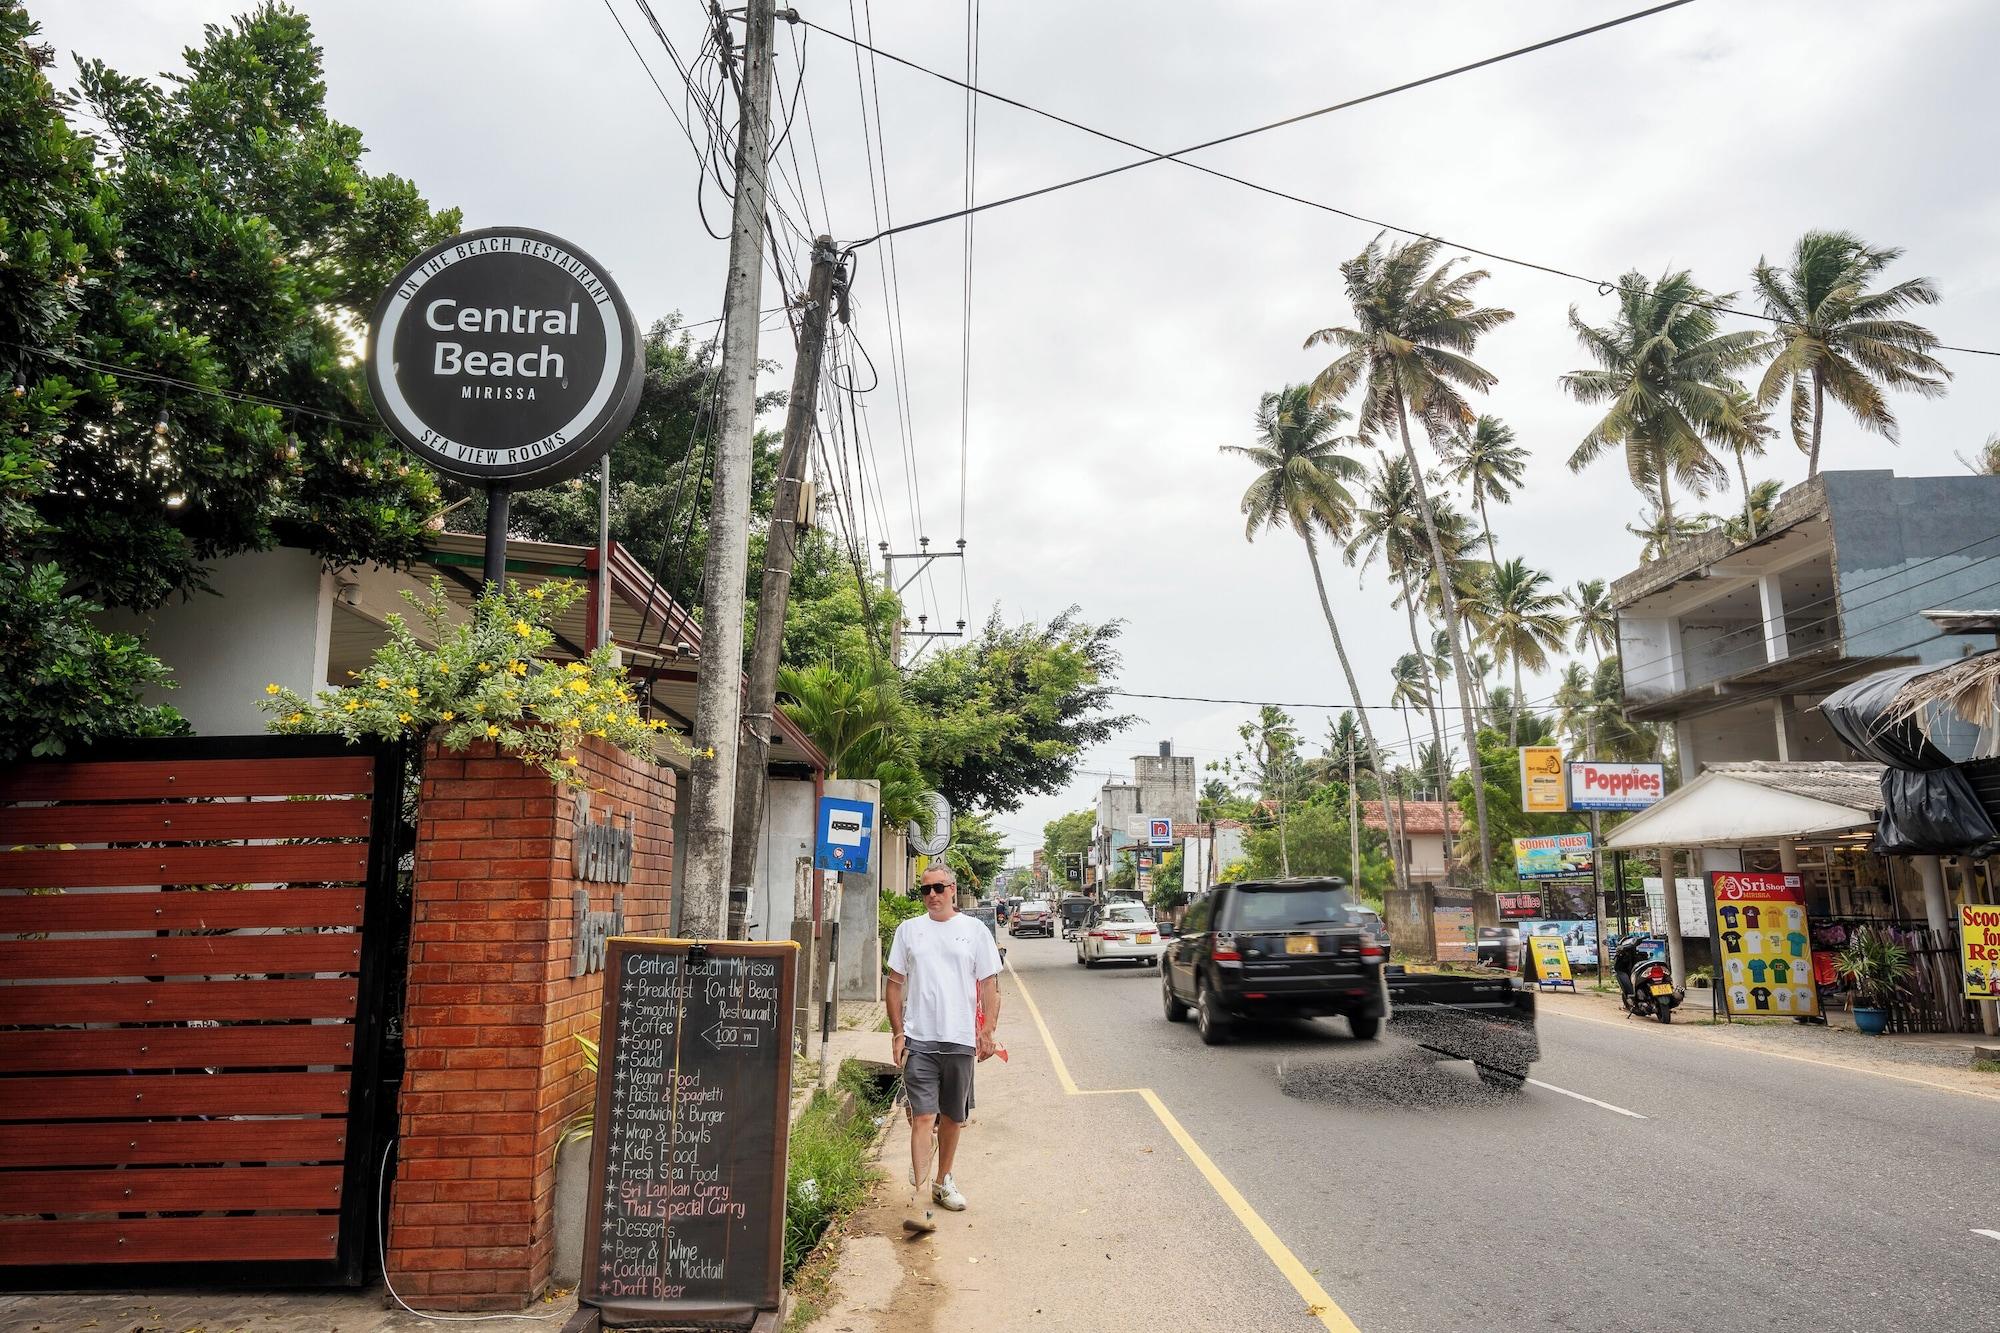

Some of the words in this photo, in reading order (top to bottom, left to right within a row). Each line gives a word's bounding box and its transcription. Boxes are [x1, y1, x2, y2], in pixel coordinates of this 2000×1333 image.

[397, 281, 419, 301] ON
[419, 250, 450, 279] THE
[456, 238, 511, 259] BEACH
[521, 239, 611, 305] RESTAURANT
[425, 298, 580, 335] Central
[433, 341, 564, 378] Beach
[461, 386, 536, 401] MIRISSA
[420, 429, 449, 454] SEA
[457, 446, 498, 464] VIEW
[509, 432, 566, 463] ROOMS
[1585, 767, 1660, 796] Poppies
[1520, 839, 1556, 850] SOORYA
[1558, 836, 1588, 847] GUEST
[1741, 878, 1766, 892] Sri
[1766, 884, 1785, 892] Shop
[1962, 905, 2000, 927] Scoo
[1967, 943, 2000, 961] Re
[627, 954, 678, 975] Central
[729, 957, 775, 977] Mirissa
[637, 978, 693, 999] Breakfast
[728, 980, 743, 999] the
[748, 980, 778, 999] Beach
[635, 1002, 687, 1018] Smoothie
[631, 1017, 674, 1035] Coffee
[715, 1029, 737, 1043] 100
[743, 1033, 752, 1042] m
[631, 1034, 663, 1054] Soup
[629, 1051, 663, 1068] Salad
[629, 1070, 663, 1090] Vegan
[668, 1069, 700, 1086] Food
[629, 1086, 659, 1103] Pasta
[662, 1088, 671, 1103] &
[675, 1086, 724, 1106] Spaghetti
[627, 1104, 672, 1122] Sandwich
[676, 1107, 685, 1121] &
[689, 1107, 726, 1126] Burger
[626, 1126, 653, 1144] Wrap
[655, 1125, 667, 1141] &
[674, 1125, 711, 1144] Bowls
[623, 1143, 653, 1161] Kids
[661, 1142, 698, 1163] Food
[621, 1162, 653, 1179] Fresh
[660, 1163, 683, 1180] Sea
[690, 1164, 719, 1181] Food
[621, 1181, 641, 1198] Sri
[646, 1181, 690, 1197] Lankan
[693, 1181, 729, 1200] Curry
[624, 1200, 651, 1216] Thai
[656, 1197, 704, 1220] Special
[707, 1197, 746, 1219] Curry
[616, 1217, 675, 1239] Desserts
[616, 1240, 643, 1259] Beer
[648, 1240, 659, 1259] &
[669, 1239, 698, 1260] Wine
[613, 1258, 658, 1278] Cocktail
[664, 1260, 672, 1277] &
[679, 1259, 725, 1280] Mocktail
[611, 1277, 648, 1297] Draft
[653, 1279, 685, 1298] Beer
